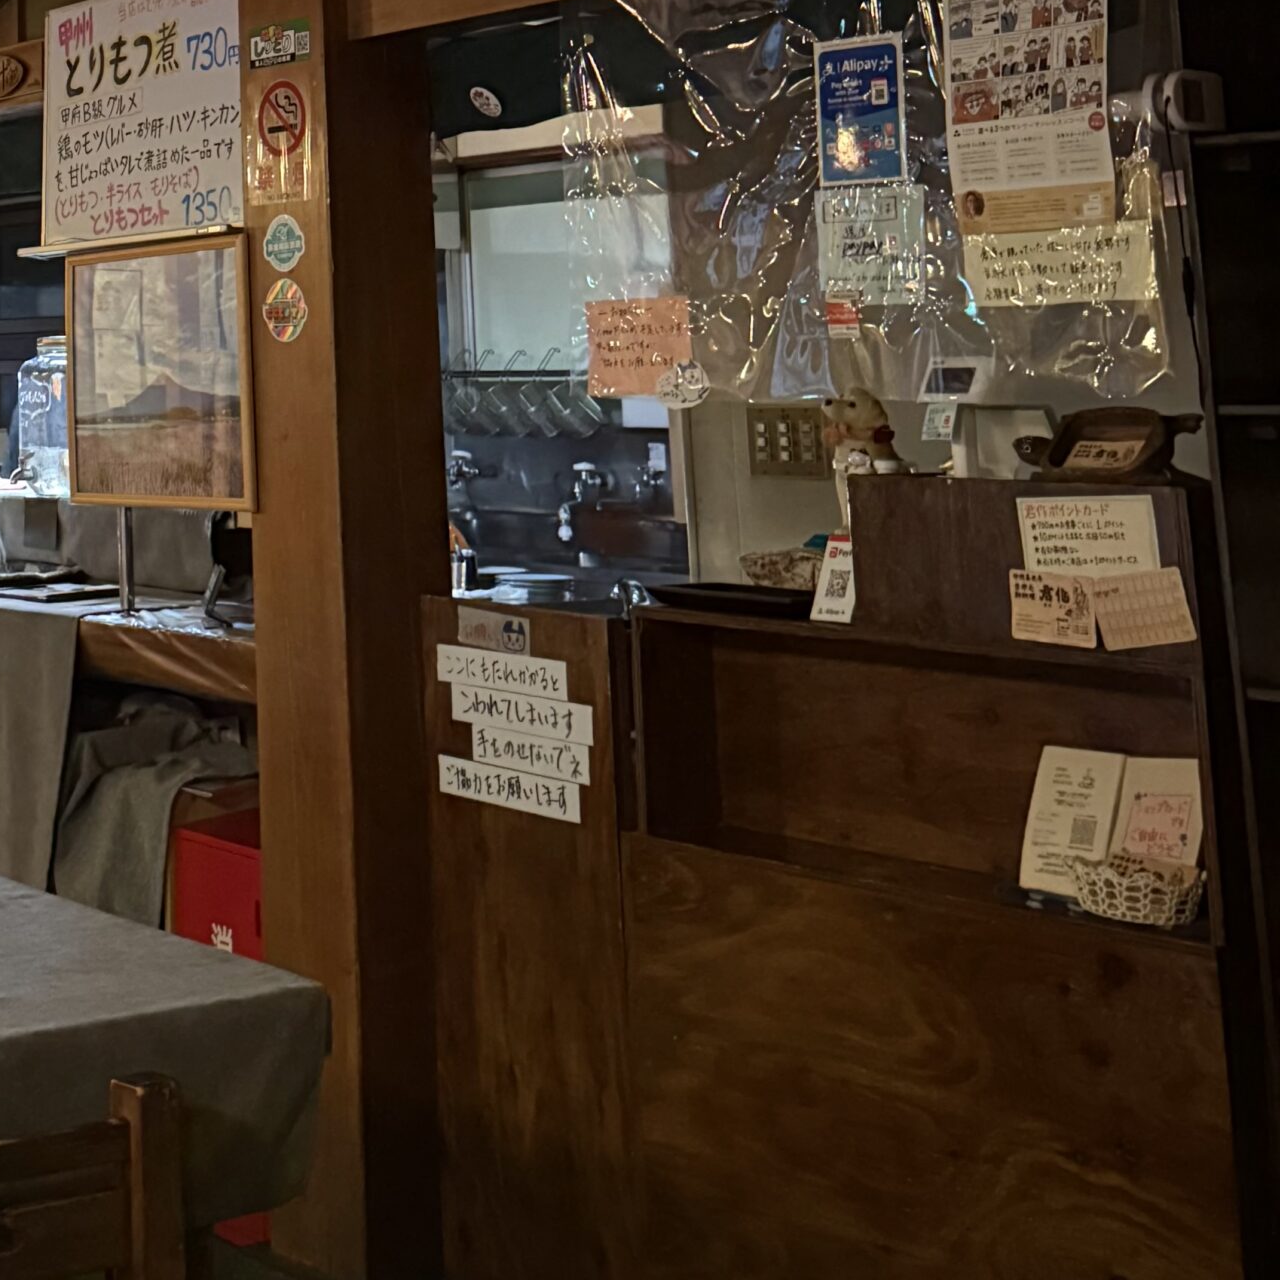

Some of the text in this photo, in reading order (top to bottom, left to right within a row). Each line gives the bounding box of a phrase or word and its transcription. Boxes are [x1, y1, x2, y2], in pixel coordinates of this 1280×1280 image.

[58, 7, 93, 57] 甲州
[66, 21, 240, 97] とりもつ煮 730円
[842, 58, 878, 73] Alipay
[61, 93, 138, 125] 甲府B級グルメ
[90, 200, 169, 235] とりもつセット
[446, 656, 559, 692] ここにもたれかかると
[460, 690, 574, 739] こわれてしまいます
[447, 766, 567, 815] ご協力をお願いします
